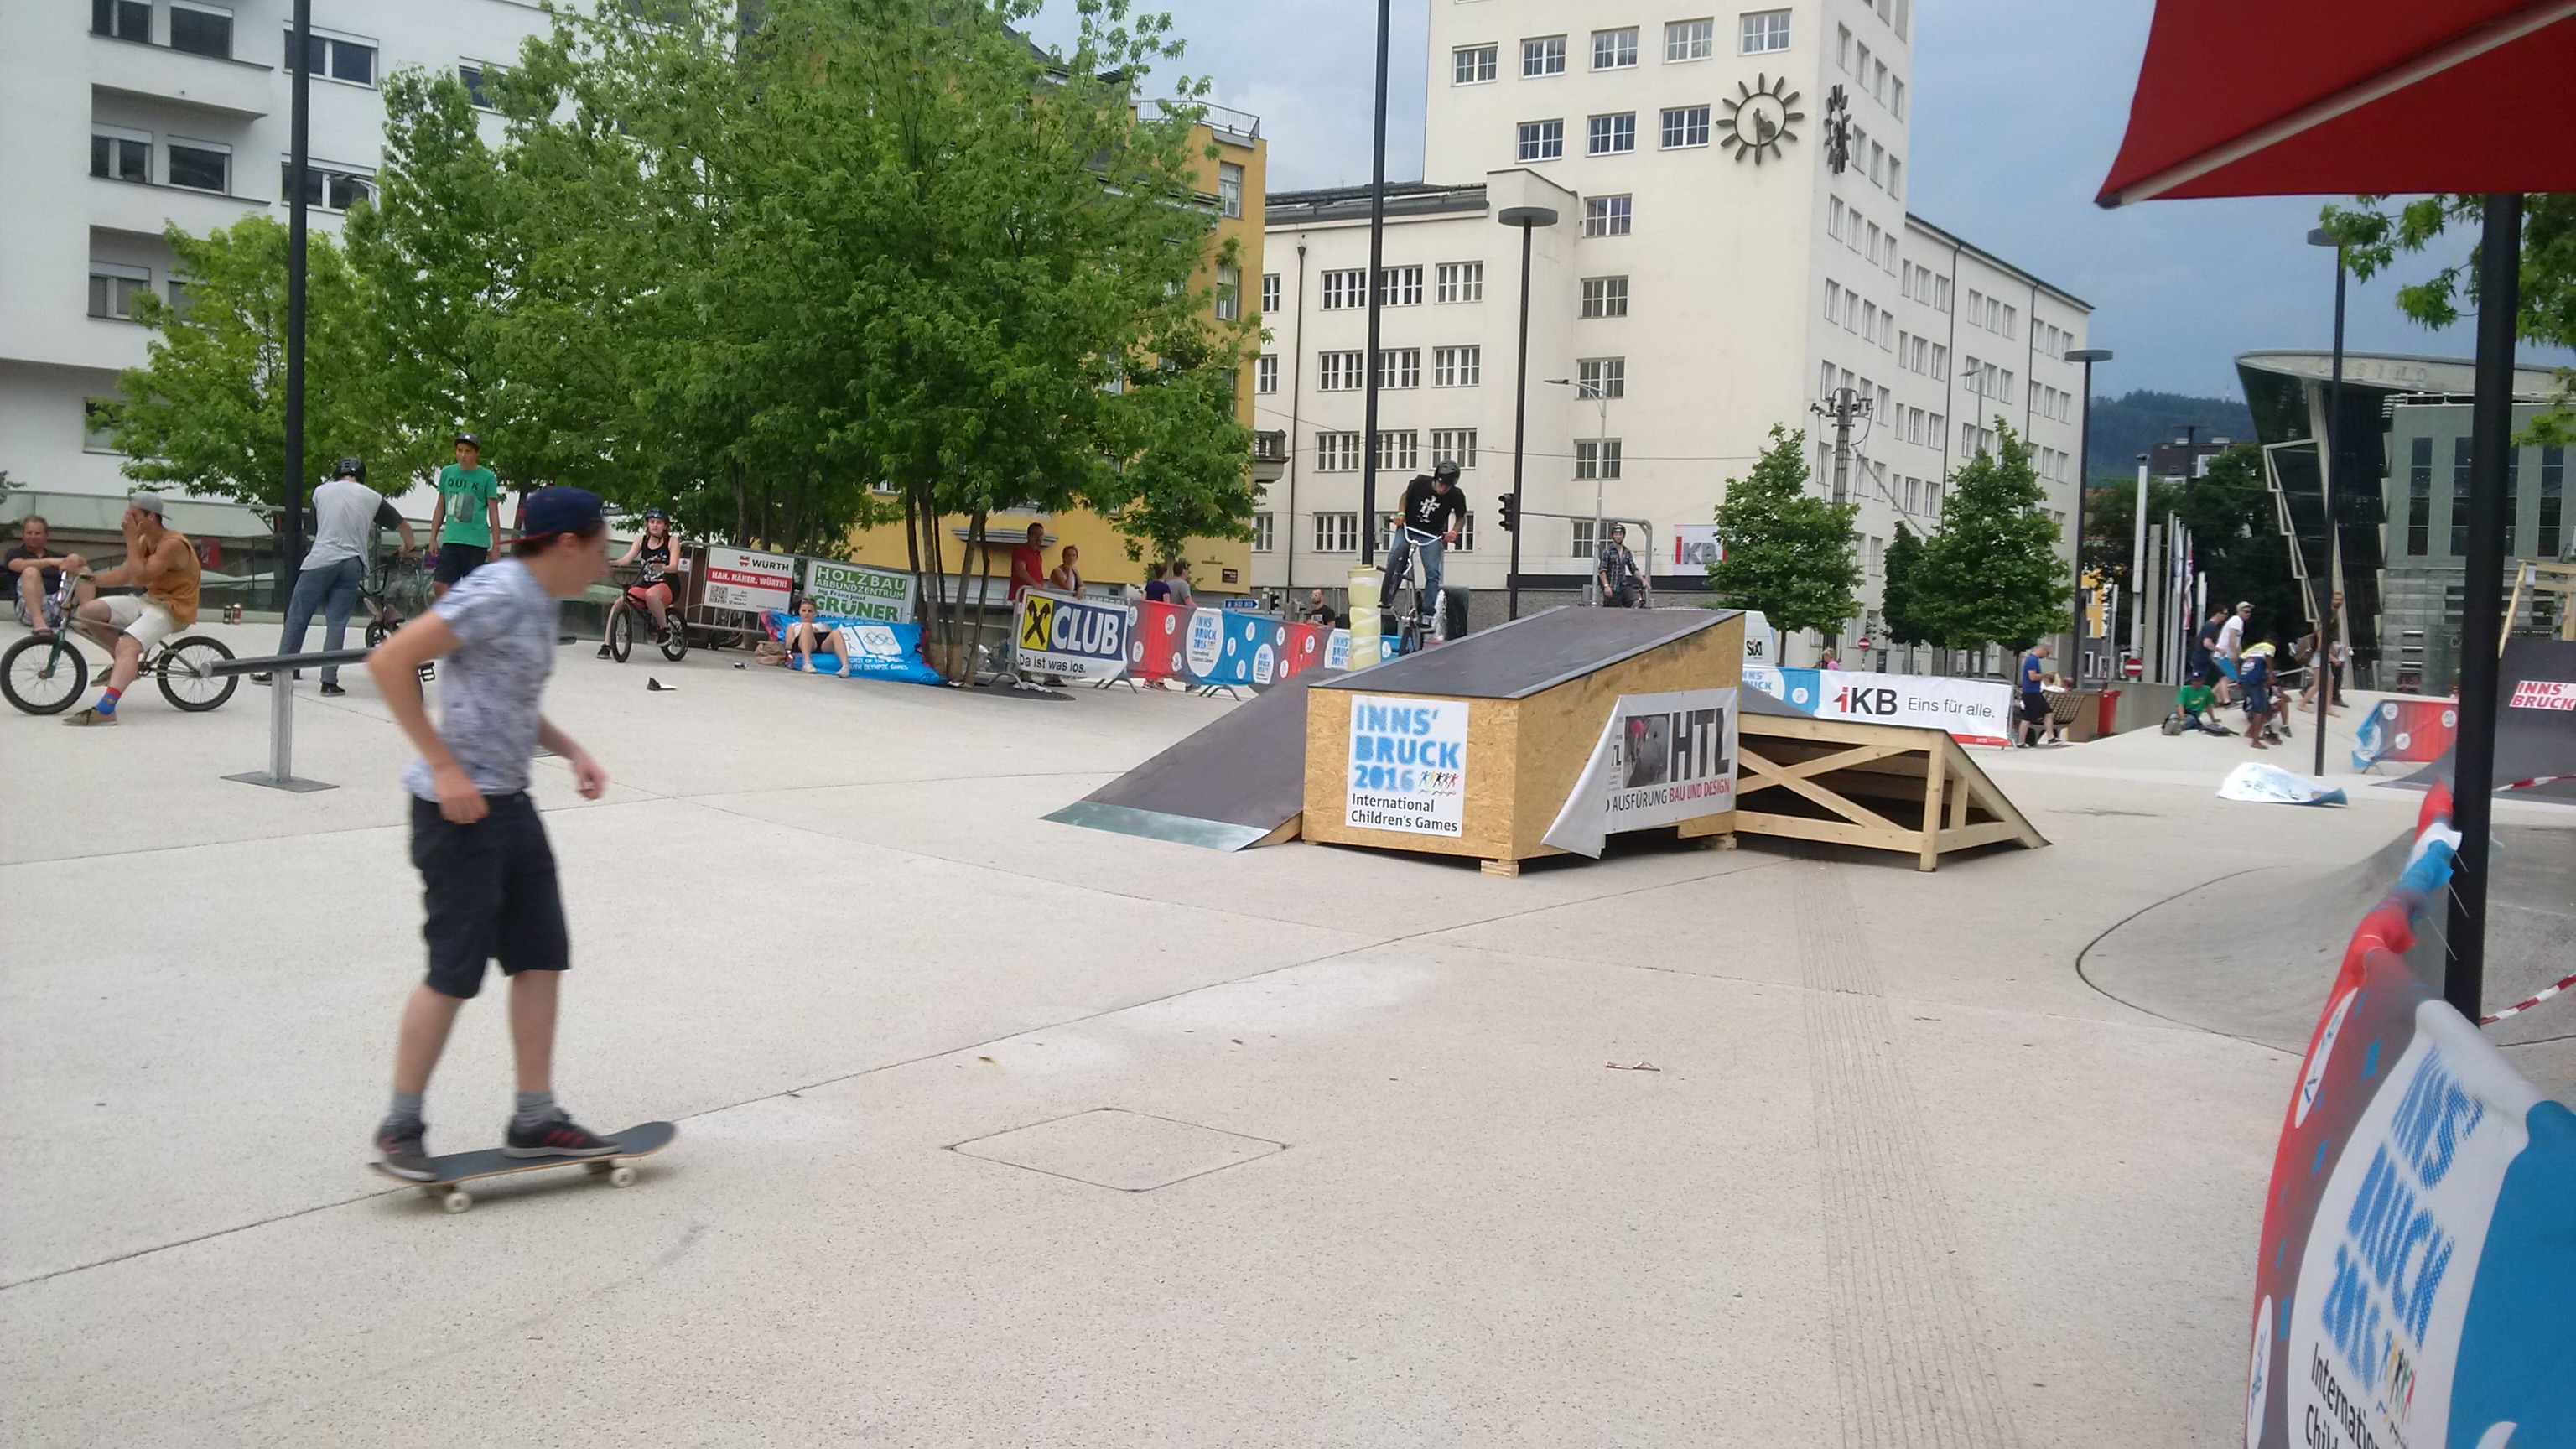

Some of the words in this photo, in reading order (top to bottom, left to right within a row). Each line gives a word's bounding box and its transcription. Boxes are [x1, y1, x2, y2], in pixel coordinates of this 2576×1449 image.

[751, 558, 789, 571] WÜRTH
[712, 571, 730, 581] NAH.
[731, 574, 758, 584] NÄHER.
[759, 577, 787, 588] WÜRTH!
[815, 579, 905, 599] ABBUNDZENTRUM
[817, 567, 906, 590] HOLZBAU
[813, 595, 899, 622] GRÜNER
[1051, 605, 1119, 655] CLUB
[1194, 627, 1217, 640] BRUCK
[1020, 654, 1031, 667] Da
[1033, 656, 1046, 669] ist
[1048, 659, 1067, 671] was
[1070, 660, 1087, 673] los.
[1908, 697, 1939, 712] Eins
[1944, 699, 1963, 714] für
[1966, 703, 1995, 719] alle.
[2511, 694, 2576, 709] BRUCK
[1356, 704, 1440, 736] INNS'
[1354, 734, 1461, 770] BRUCK
[1670, 707, 1730, 782] HTL
[1353, 764, 1415, 792] 2016
[1352, 793, 1435, 813] International
[1613, 789, 1667, 812] AUSFÜRUNG
[1669, 786, 1685, 803] BAU
[1687, 783, 1702, 800] UND
[1704, 778, 1730, 799] DESIGN
[1351, 810, 1412, 827] Children's
[1415, 816, 1458, 832] Games
